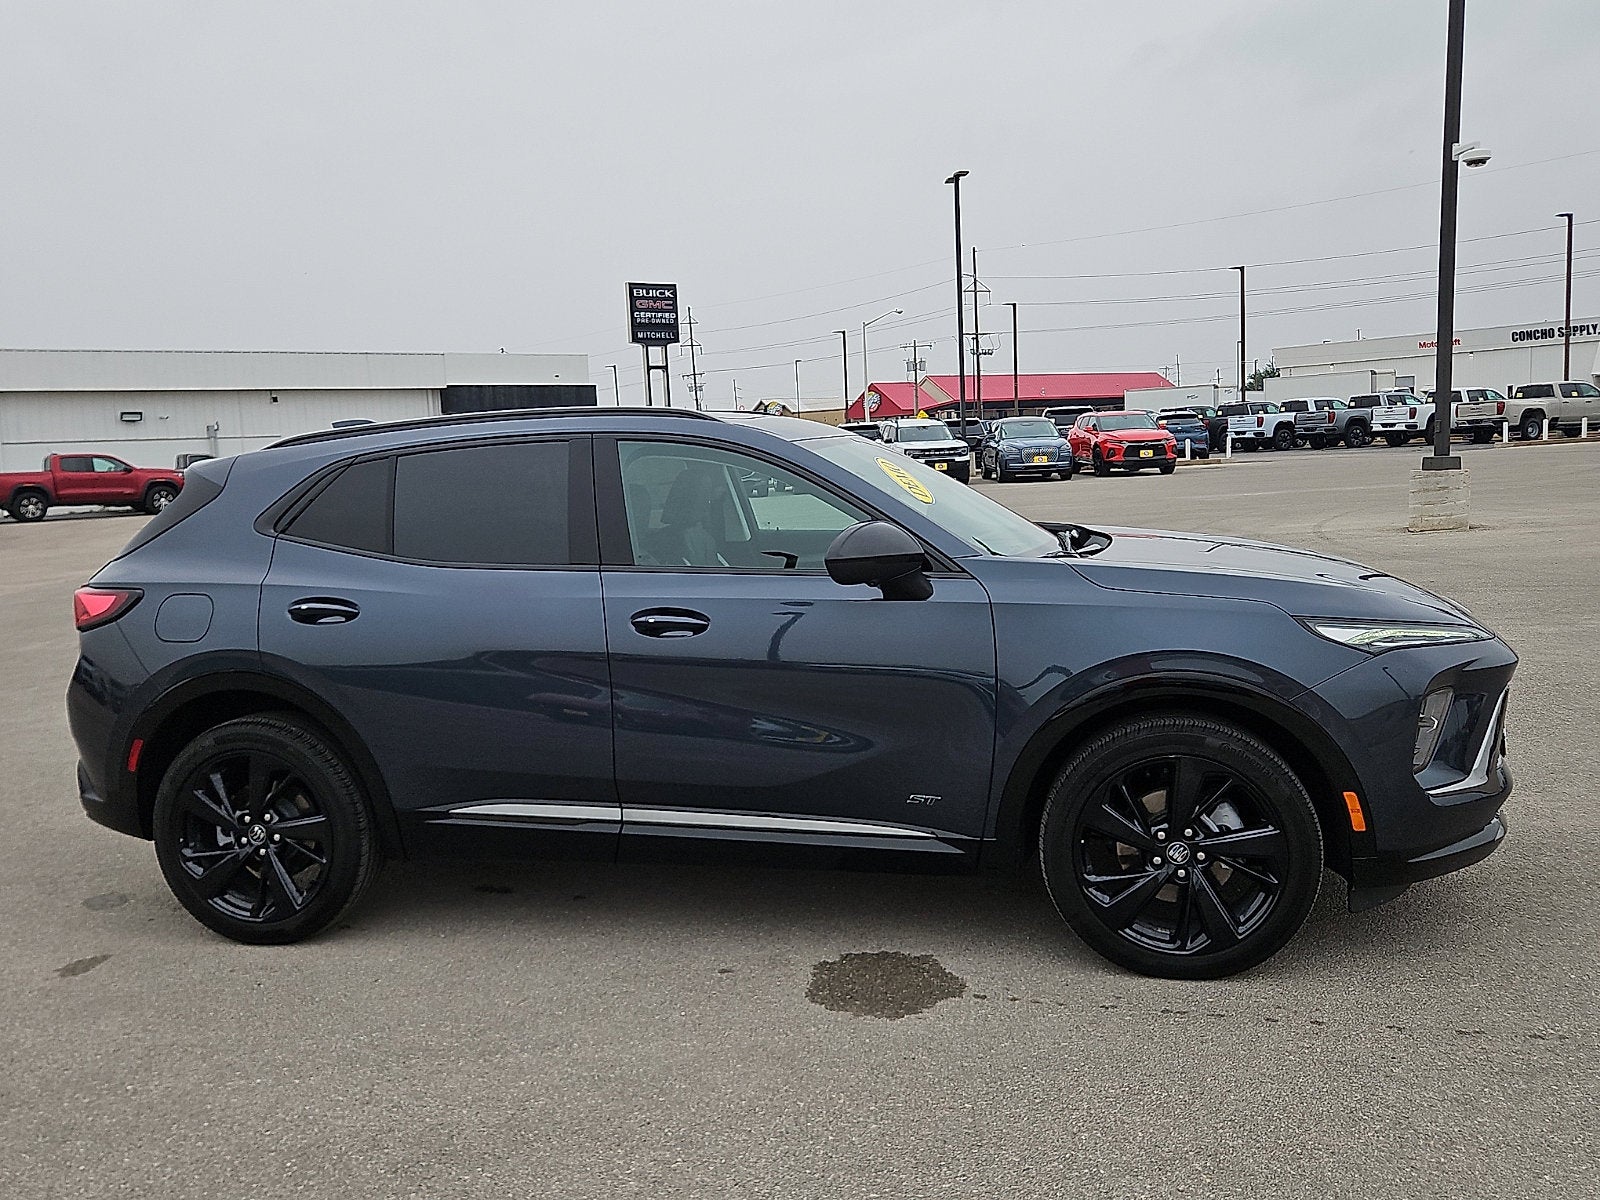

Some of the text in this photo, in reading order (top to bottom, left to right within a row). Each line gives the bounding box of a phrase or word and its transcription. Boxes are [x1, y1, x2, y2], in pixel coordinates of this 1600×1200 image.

[633, 288, 674, 298] BUICK
[635, 299, 674, 309] GMC
[633, 311, 677, 319] CERTIFIED
[637, 331, 675, 339] MITCHELL
[1511, 327, 1555, 342] CONCHO
[1418, 338, 1461, 348] Motoft
[906, 794, 942, 806] ST
